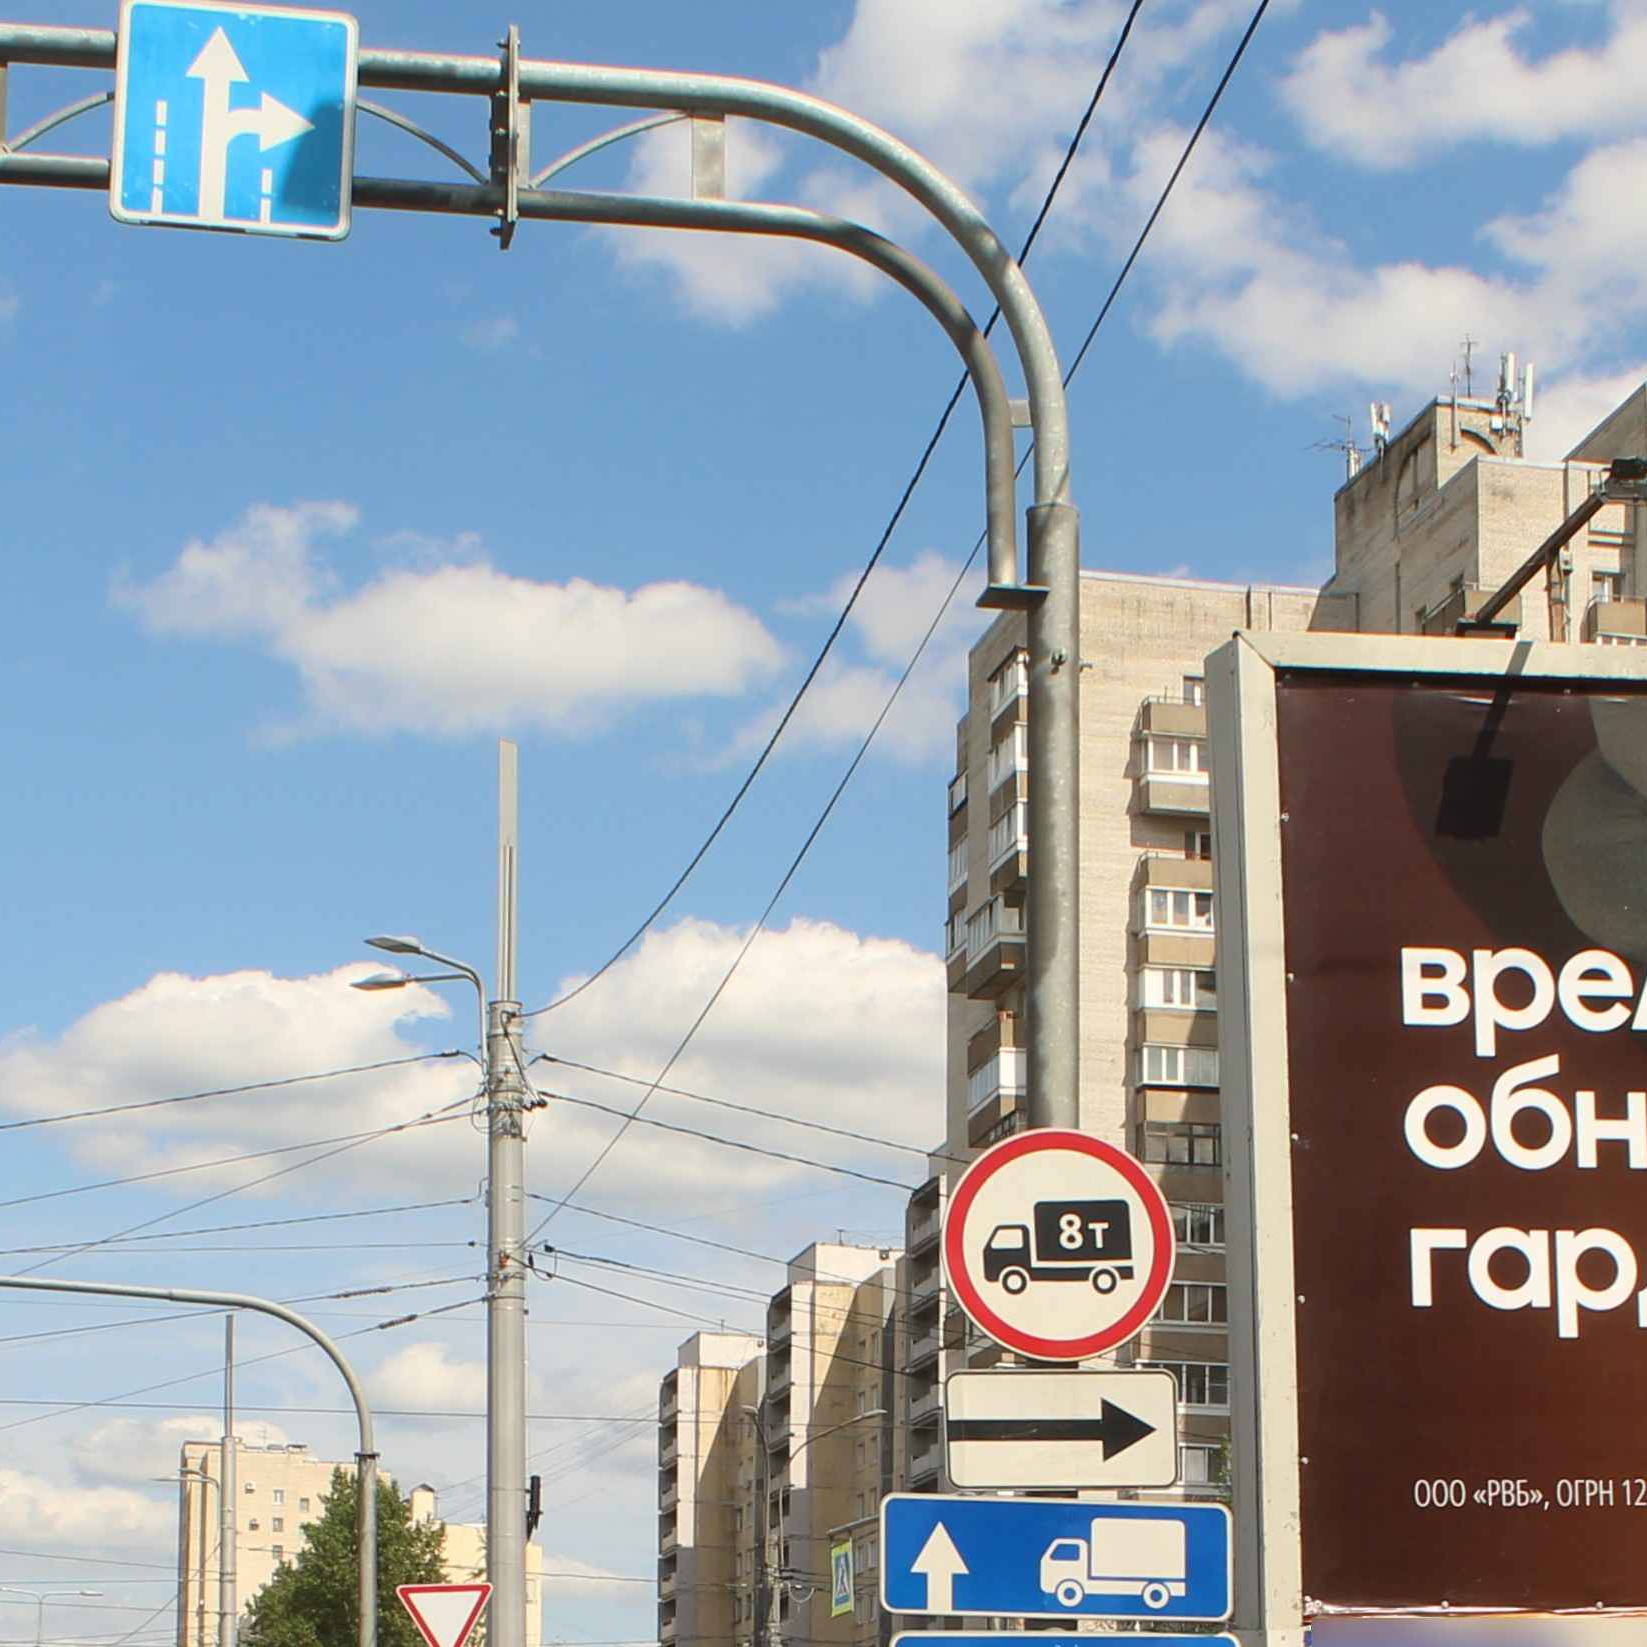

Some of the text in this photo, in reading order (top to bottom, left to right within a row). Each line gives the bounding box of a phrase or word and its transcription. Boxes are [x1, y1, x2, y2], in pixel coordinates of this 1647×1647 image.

[1414, 1479, 1466, 1507] ООО
[1472, 1478, 1550, 1511] «РВБ»,
[1556, 1478, 1614, 1507] ОГРН
